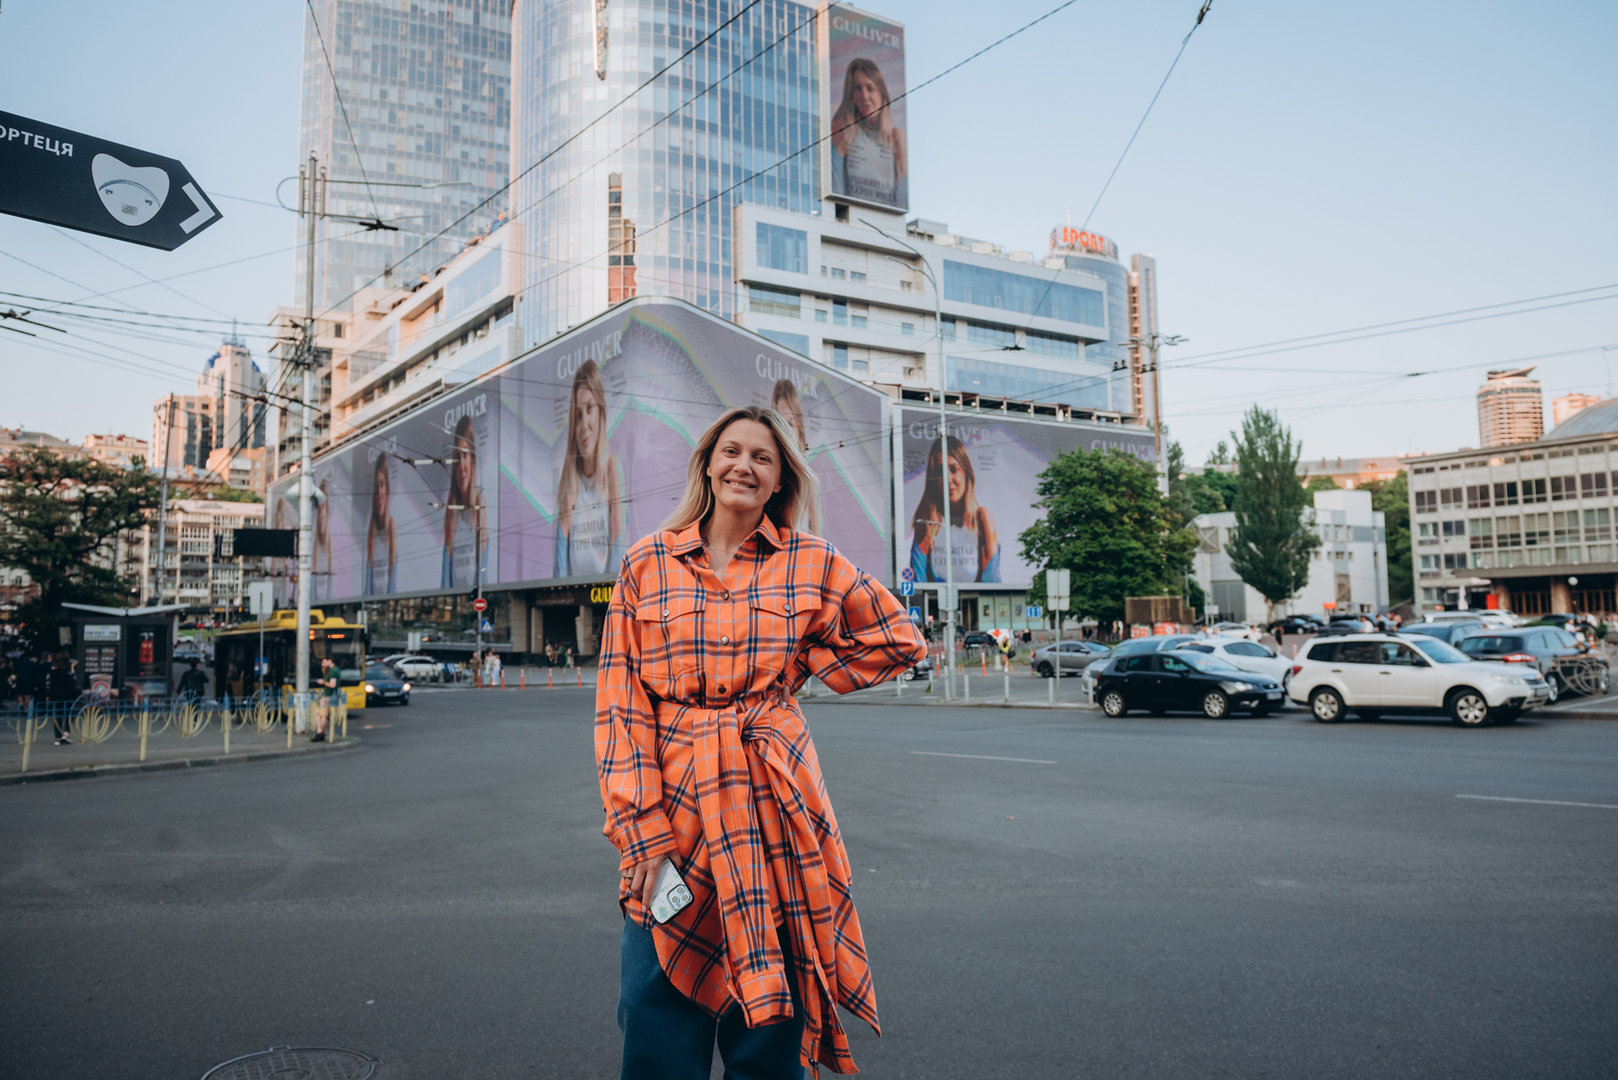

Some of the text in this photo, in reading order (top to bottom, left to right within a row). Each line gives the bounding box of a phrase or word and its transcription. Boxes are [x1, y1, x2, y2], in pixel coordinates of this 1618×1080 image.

[832, 16, 901, 50] GULLIVER
[1062, 227, 1104, 252] SPORT
[557, 330, 622, 380] GULLIVER
[756, 353, 818, 399] GULLIVER
